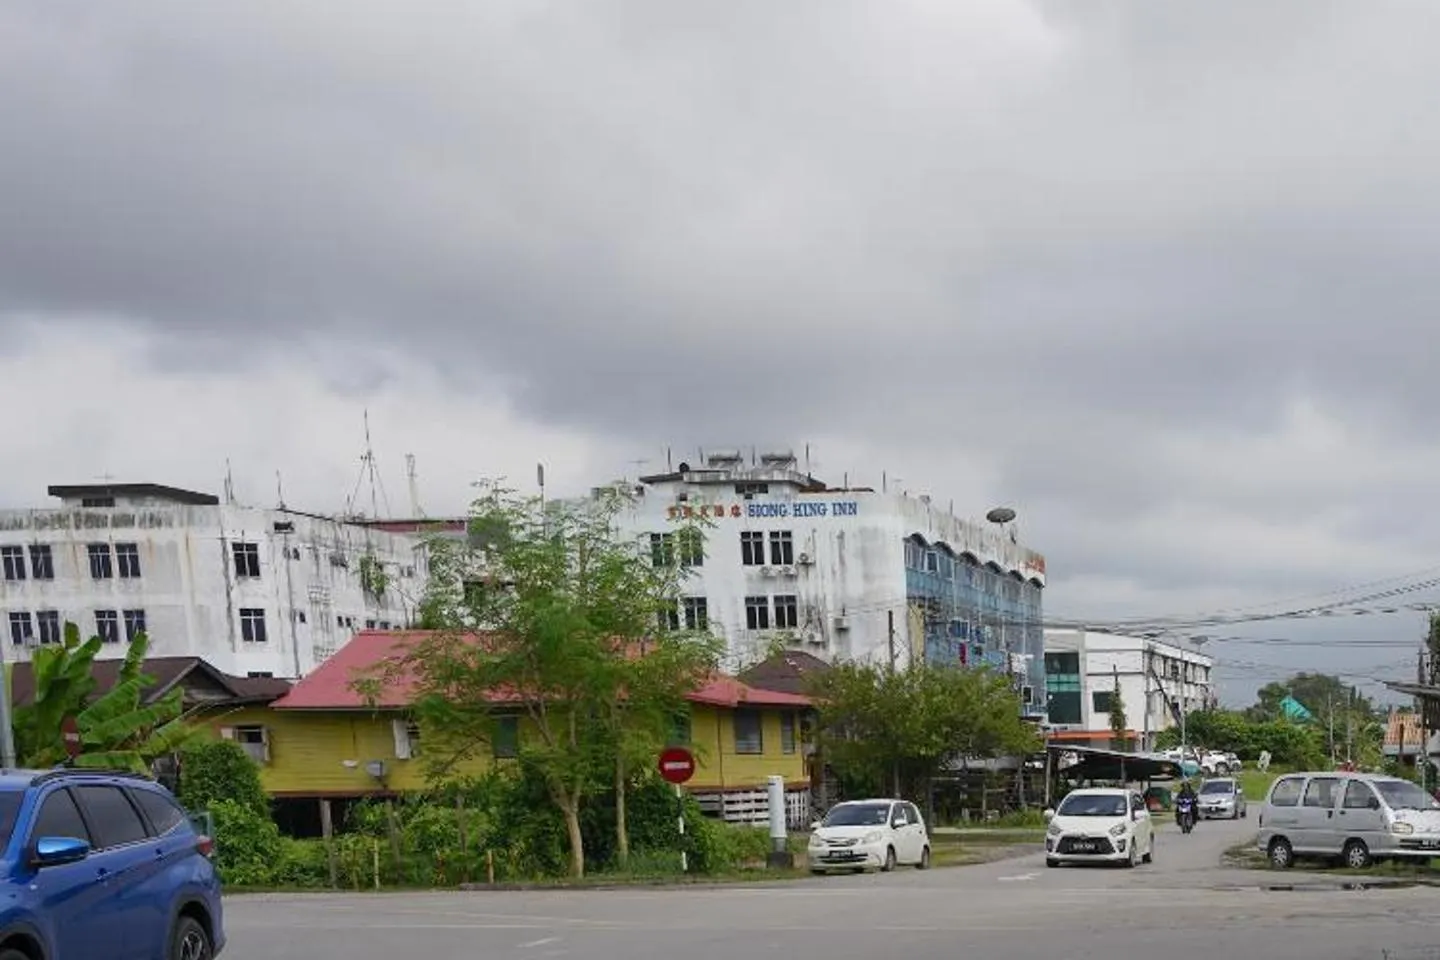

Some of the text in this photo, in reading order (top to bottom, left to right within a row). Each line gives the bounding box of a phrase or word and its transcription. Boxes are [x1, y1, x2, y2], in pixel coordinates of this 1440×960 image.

[748, 501, 857, 517] SIONG HING INN
